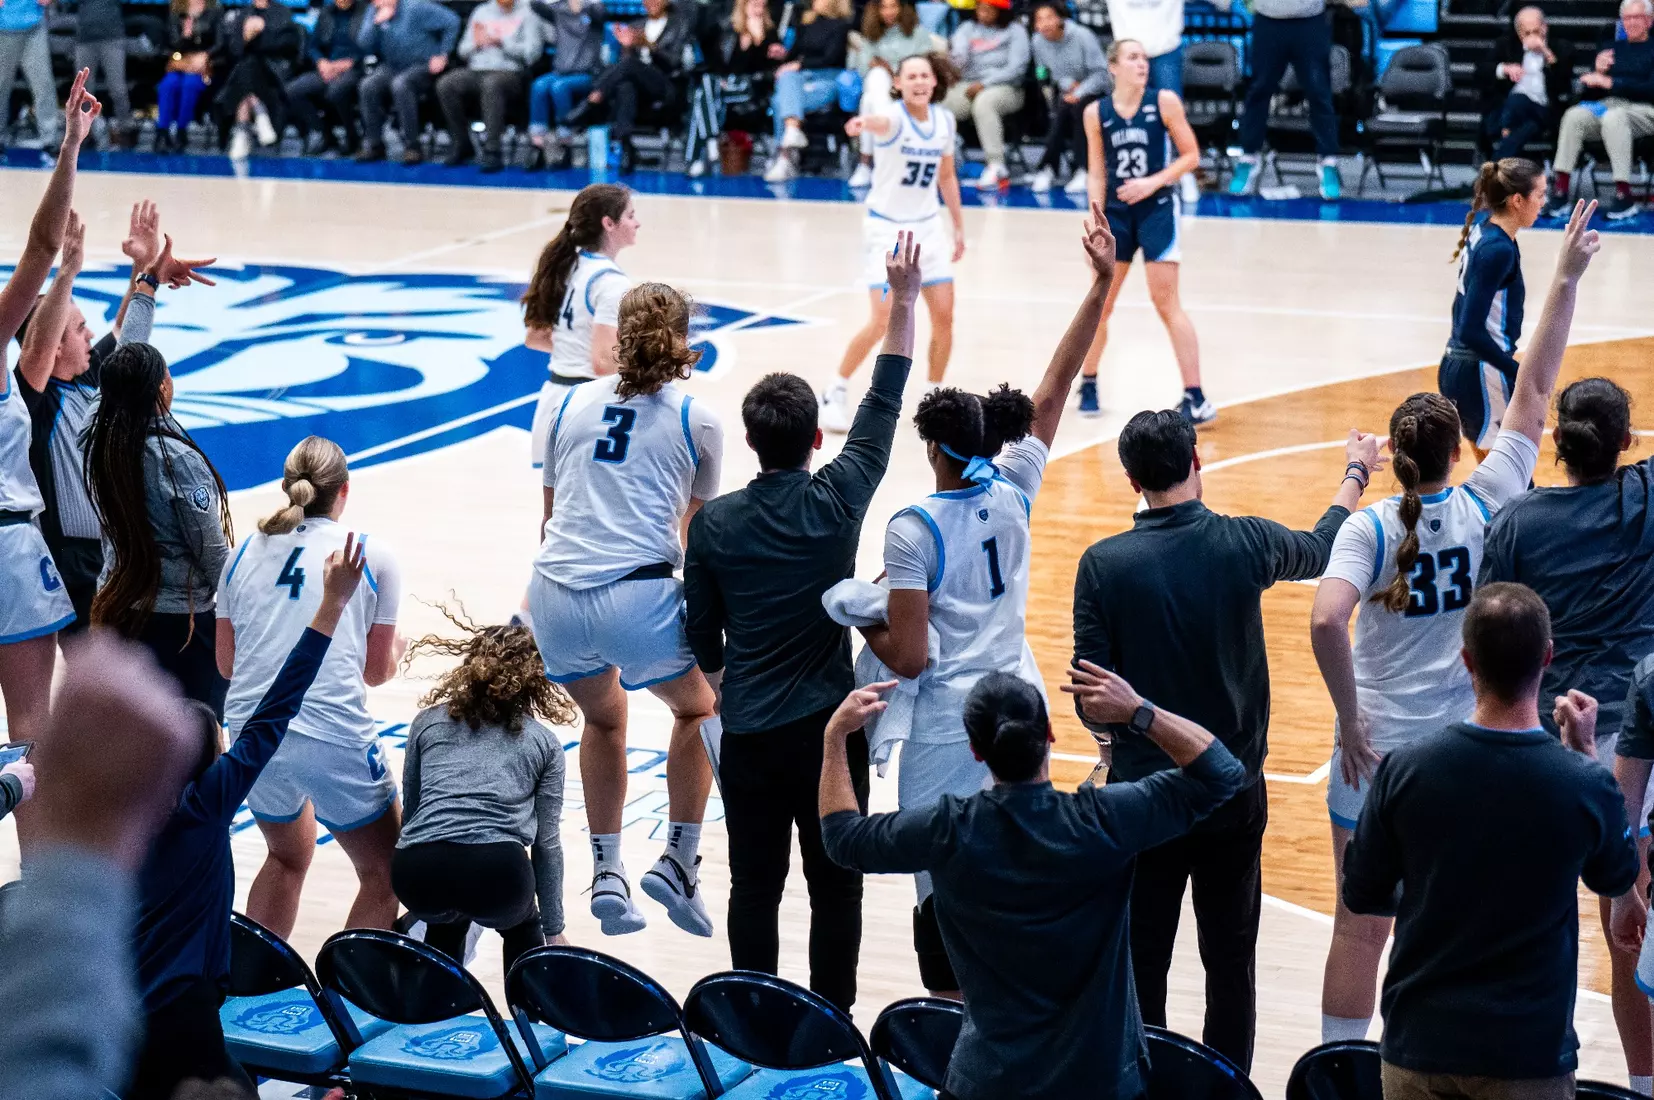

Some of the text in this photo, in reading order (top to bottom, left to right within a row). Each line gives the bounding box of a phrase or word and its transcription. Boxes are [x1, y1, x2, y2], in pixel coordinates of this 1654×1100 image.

[901, 161, 936, 187] 35
[1115, 147, 1149, 178] 23
[594, 405, 637, 464] 3
[275, 546, 306, 601] 4
[981, 536, 1005, 600] 1
[1404, 546, 1472, 617] 33
